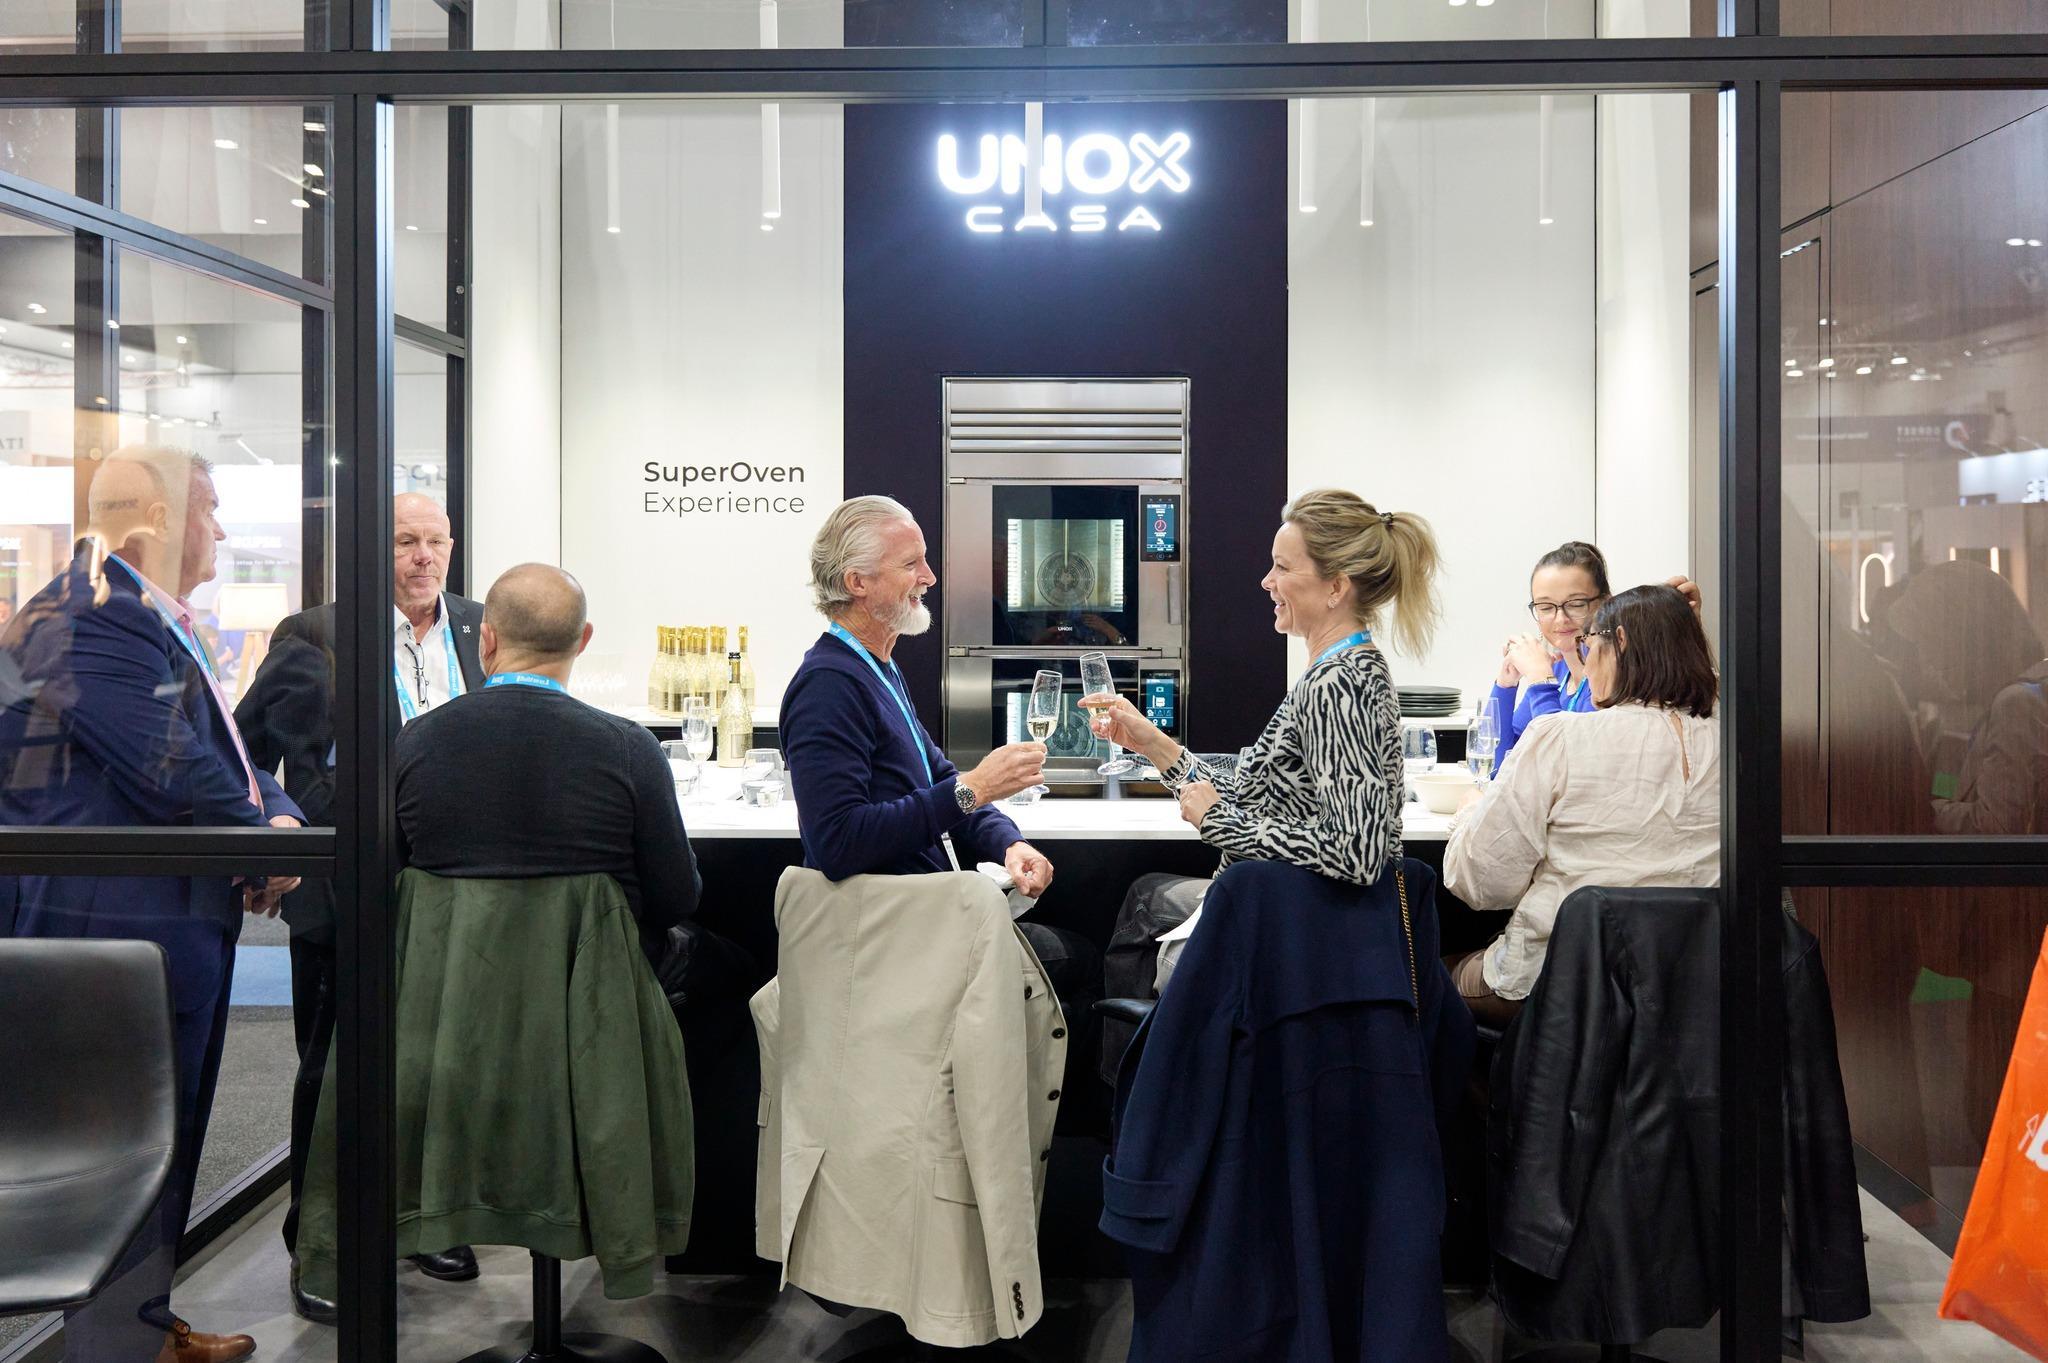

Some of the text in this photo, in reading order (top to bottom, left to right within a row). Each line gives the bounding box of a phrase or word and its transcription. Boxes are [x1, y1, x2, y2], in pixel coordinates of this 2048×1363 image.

[937, 132, 1191, 195] UNOX
[965, 205, 1162, 232] CASA
[644, 461, 805, 487] SuperOven
[644, 491, 805, 517] Experience
